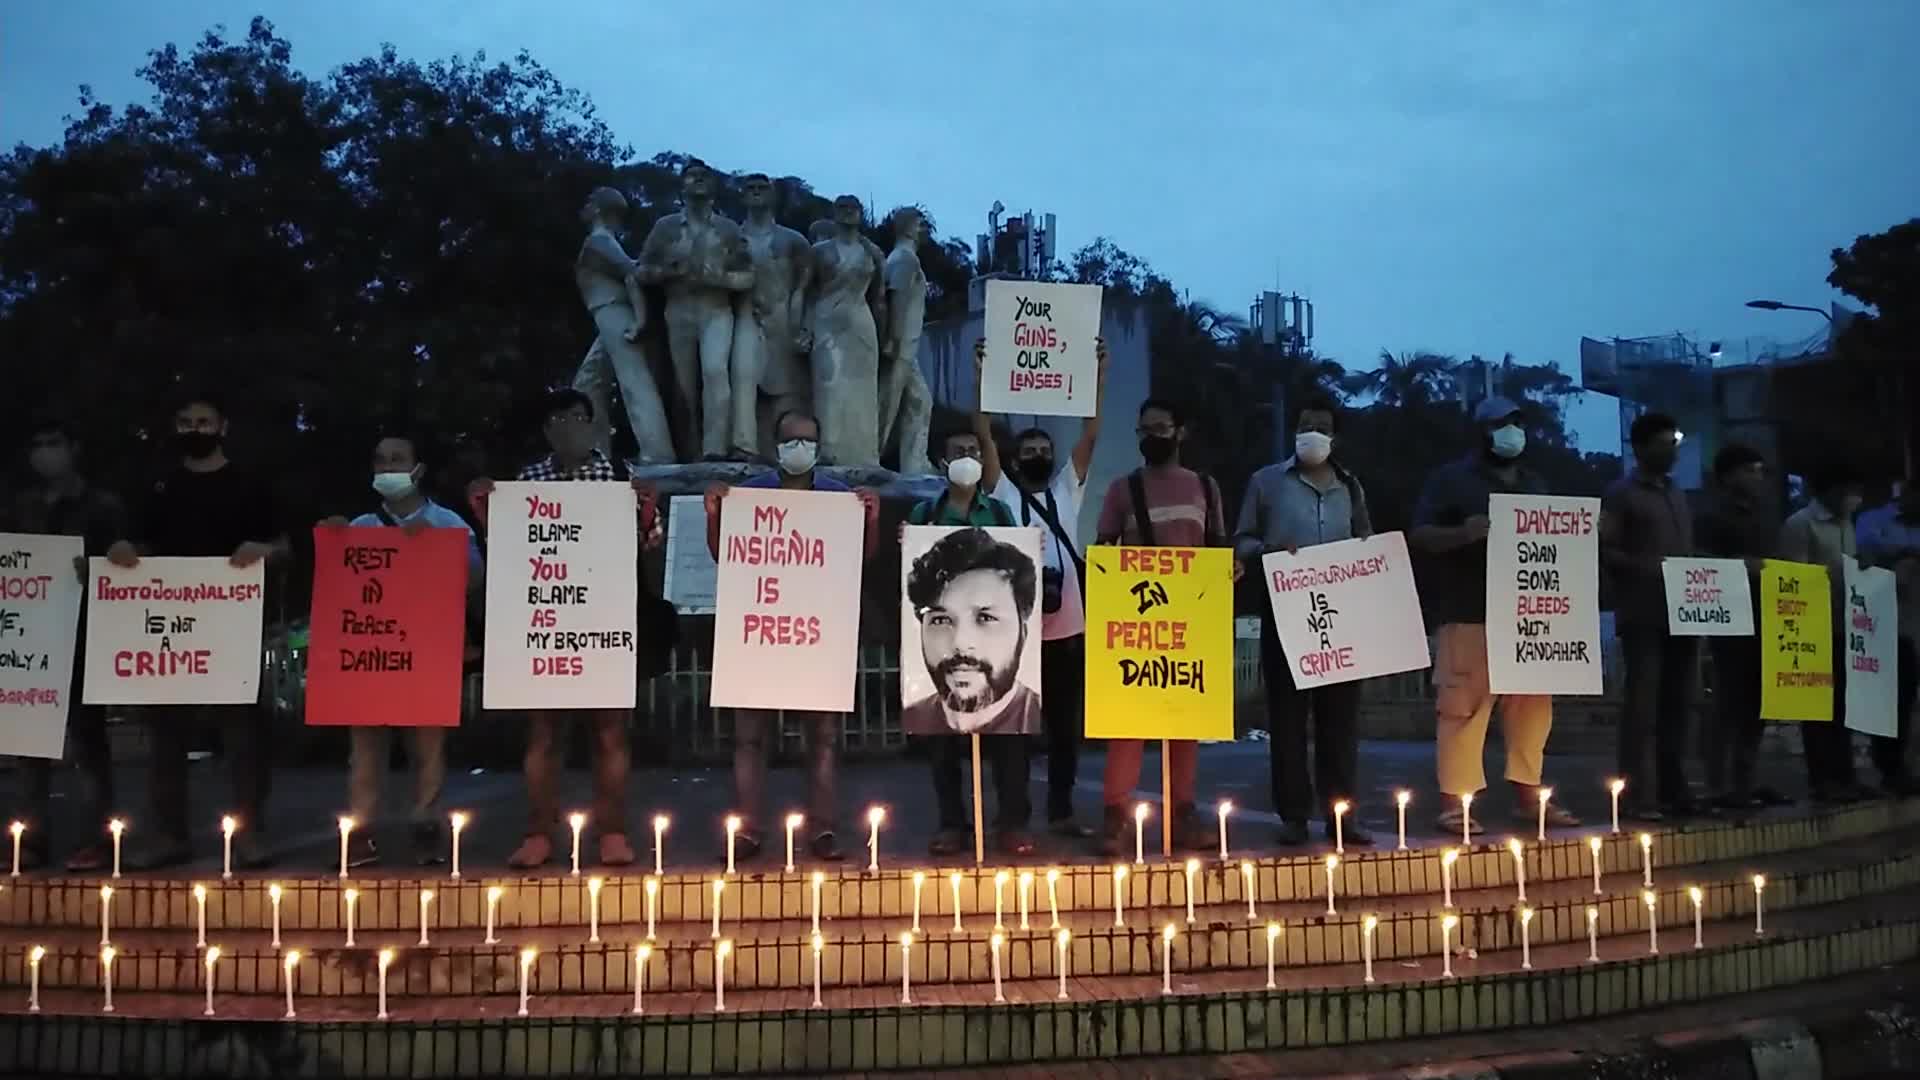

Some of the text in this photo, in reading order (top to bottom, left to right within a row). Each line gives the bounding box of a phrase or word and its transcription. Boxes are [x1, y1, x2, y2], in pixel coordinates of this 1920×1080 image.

[1015, 295, 1052, 322] YOUR
[1014, 323, 1067, 354] GUNS,
[1017, 350, 1051, 369] OUR
[525, 495, 562, 520] YOU
[754, 505, 789, 535] MY
[1514, 505, 1593, 536] DANISH'S
[527, 524, 583, 544] BLAME
[0, 551, 32, 569] ON'T
[343, 546, 399, 575] REST
[540, 545, 558, 556] and
[727, 529, 825, 567] INSIGNIA
[1517, 541, 1557, 565] SWAN
[528, 556, 568, 582] YOU
[1119, 549, 1196, 575] REST
[1271, 554, 1389, 594] PHOTOJOURNALISM
[0, 575, 53, 601] HOOT
[97, 575, 262, 603] PHOTOJOURNALISM
[362, 577, 384, 605] IN
[757, 576, 780, 604] IS
[1516, 569, 1560, 592] SONG
[527, 586, 589, 605] BLAME
[1130, 580, 1169, 615] IN
[1309, 591, 1329, 612] IS
[1517, 595, 1570, 616] BLEEDS
[1685, 588, 1723, 605] SHOOT
[145, 608, 196, 634] IS NOT
[530, 609, 557, 628] AS
[743, 614, 821, 646] PRESS
[1307, 609, 1338, 633] NOT
[1517, 617, 1550, 636] WITH
[160, 636, 171, 651] A
[526, 631, 634, 652] MY BROTHER
[1106, 620, 1188, 650] PEACE
[1320, 631, 1332, 650] A
[40, 654, 49, 670] A
[114, 650, 211, 677] CRIME
[340, 646, 413, 673] DANISH
[1299, 647, 1355, 678] CRIME
[1516, 640, 1590, 664] KANDAHAR
[532, 657, 584, 676] DIES
[1118, 655, 1205, 694] DANISH
